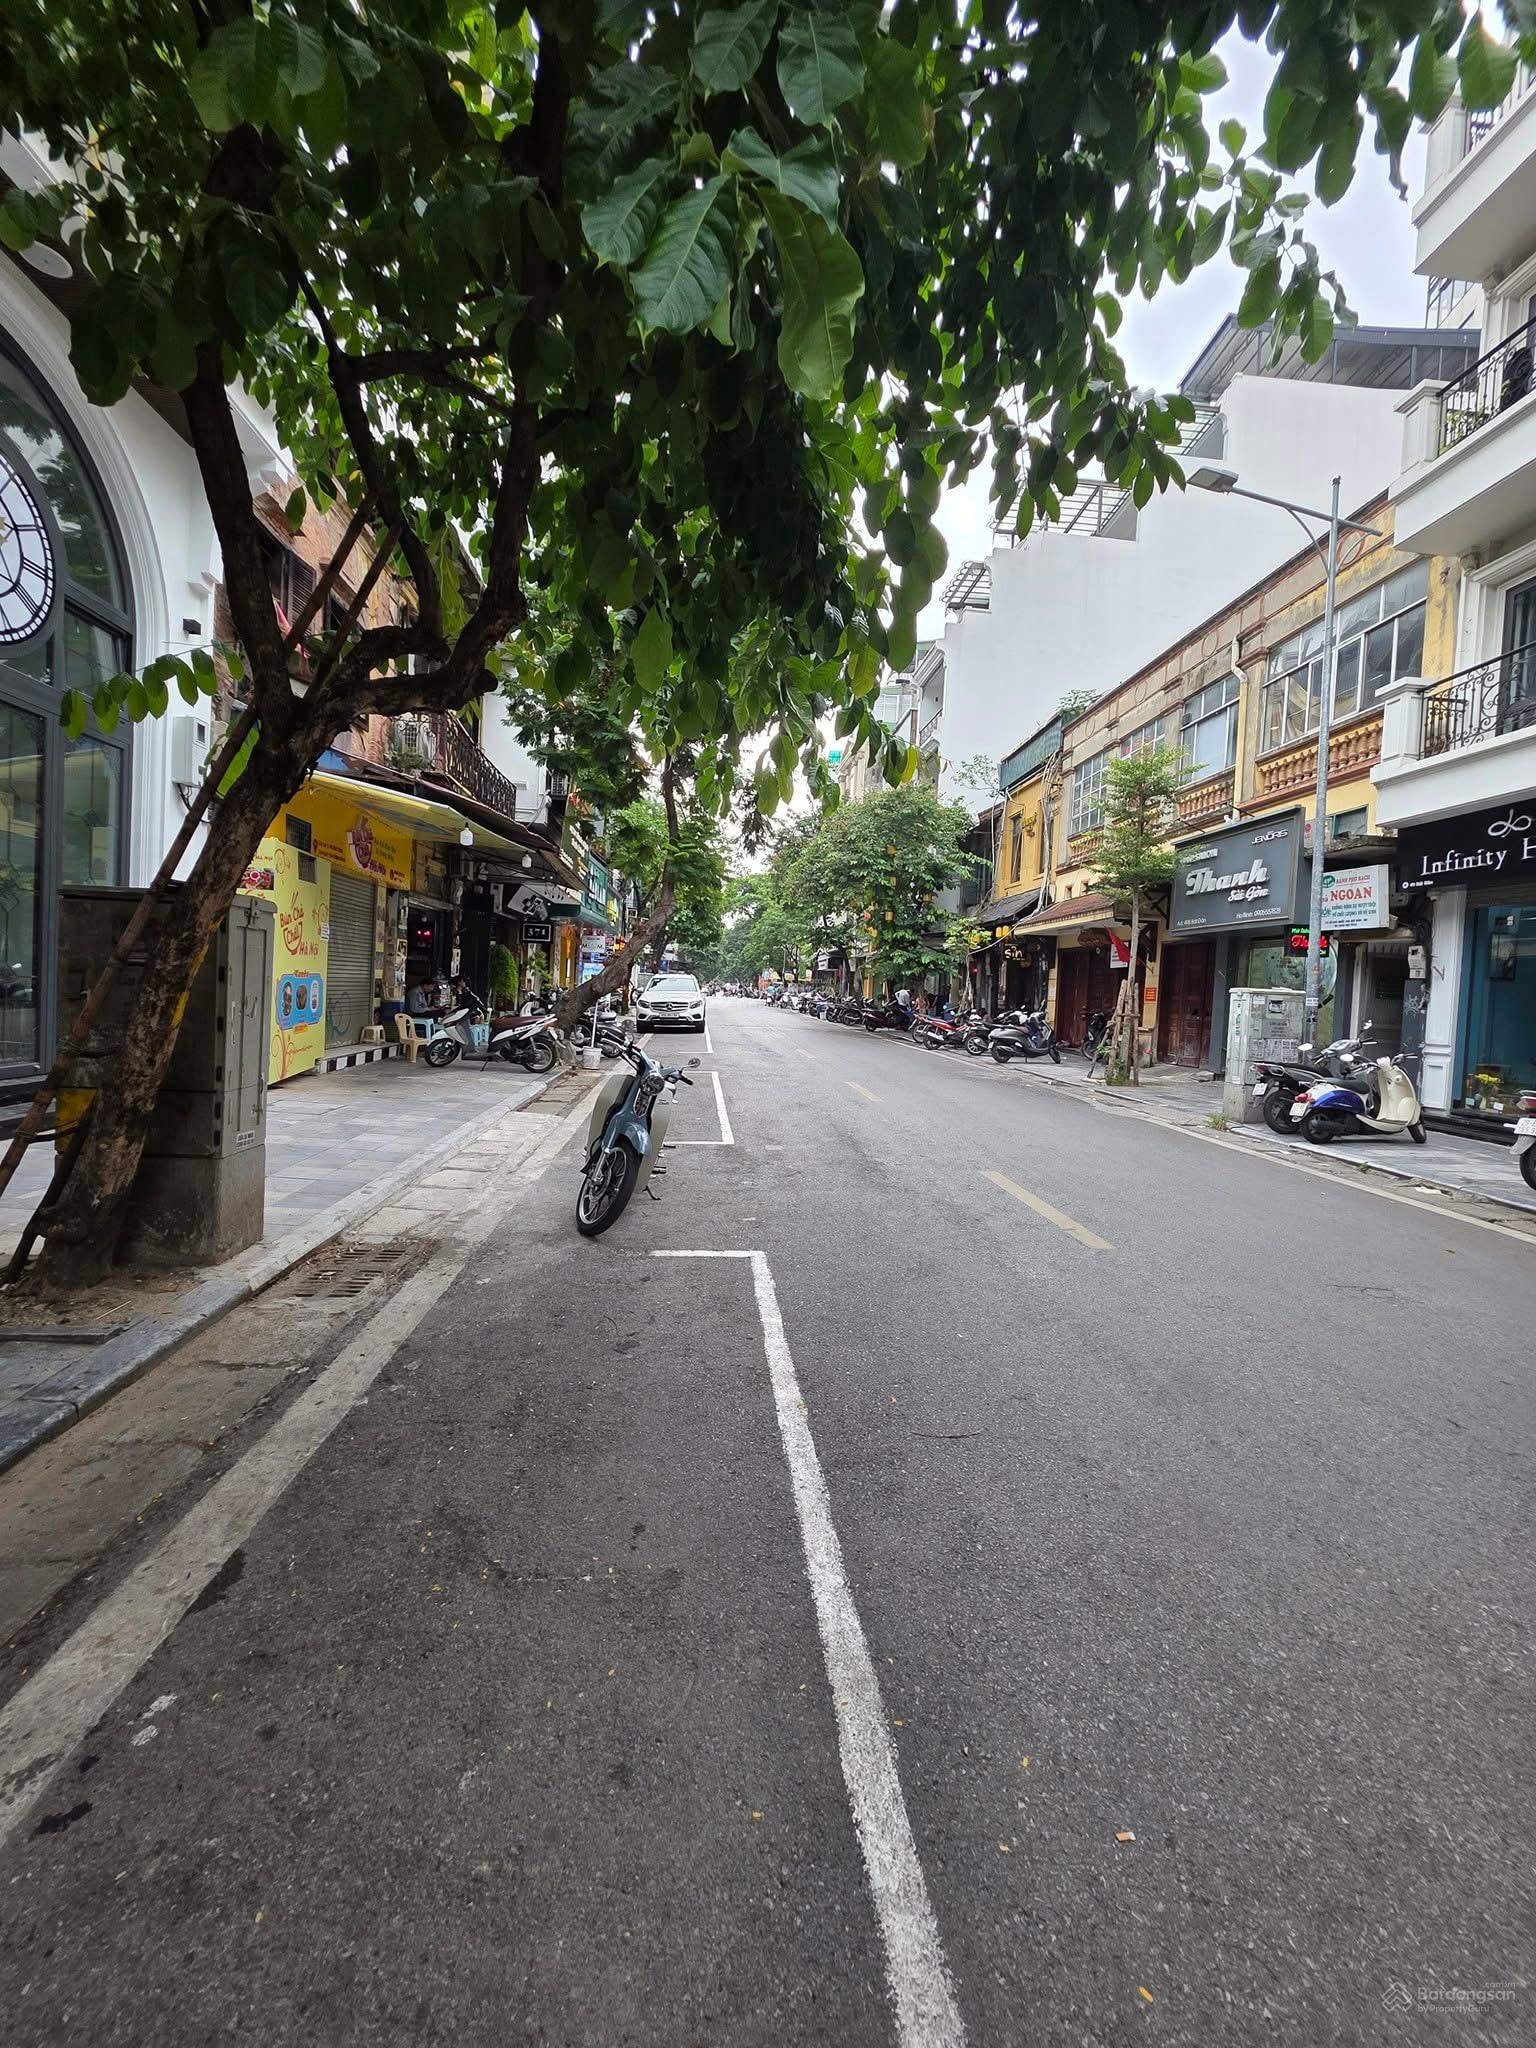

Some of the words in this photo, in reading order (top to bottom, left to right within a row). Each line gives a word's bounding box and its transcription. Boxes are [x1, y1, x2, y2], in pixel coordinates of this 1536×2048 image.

[1421, 848, 1507, 876] Infinity
[1185, 859, 1269, 896] Thanh
[1245, 885, 1270, 902] Gòn
[1330, 886, 1372, 902] NGOAN
[527, 928, 546, 937] 371
